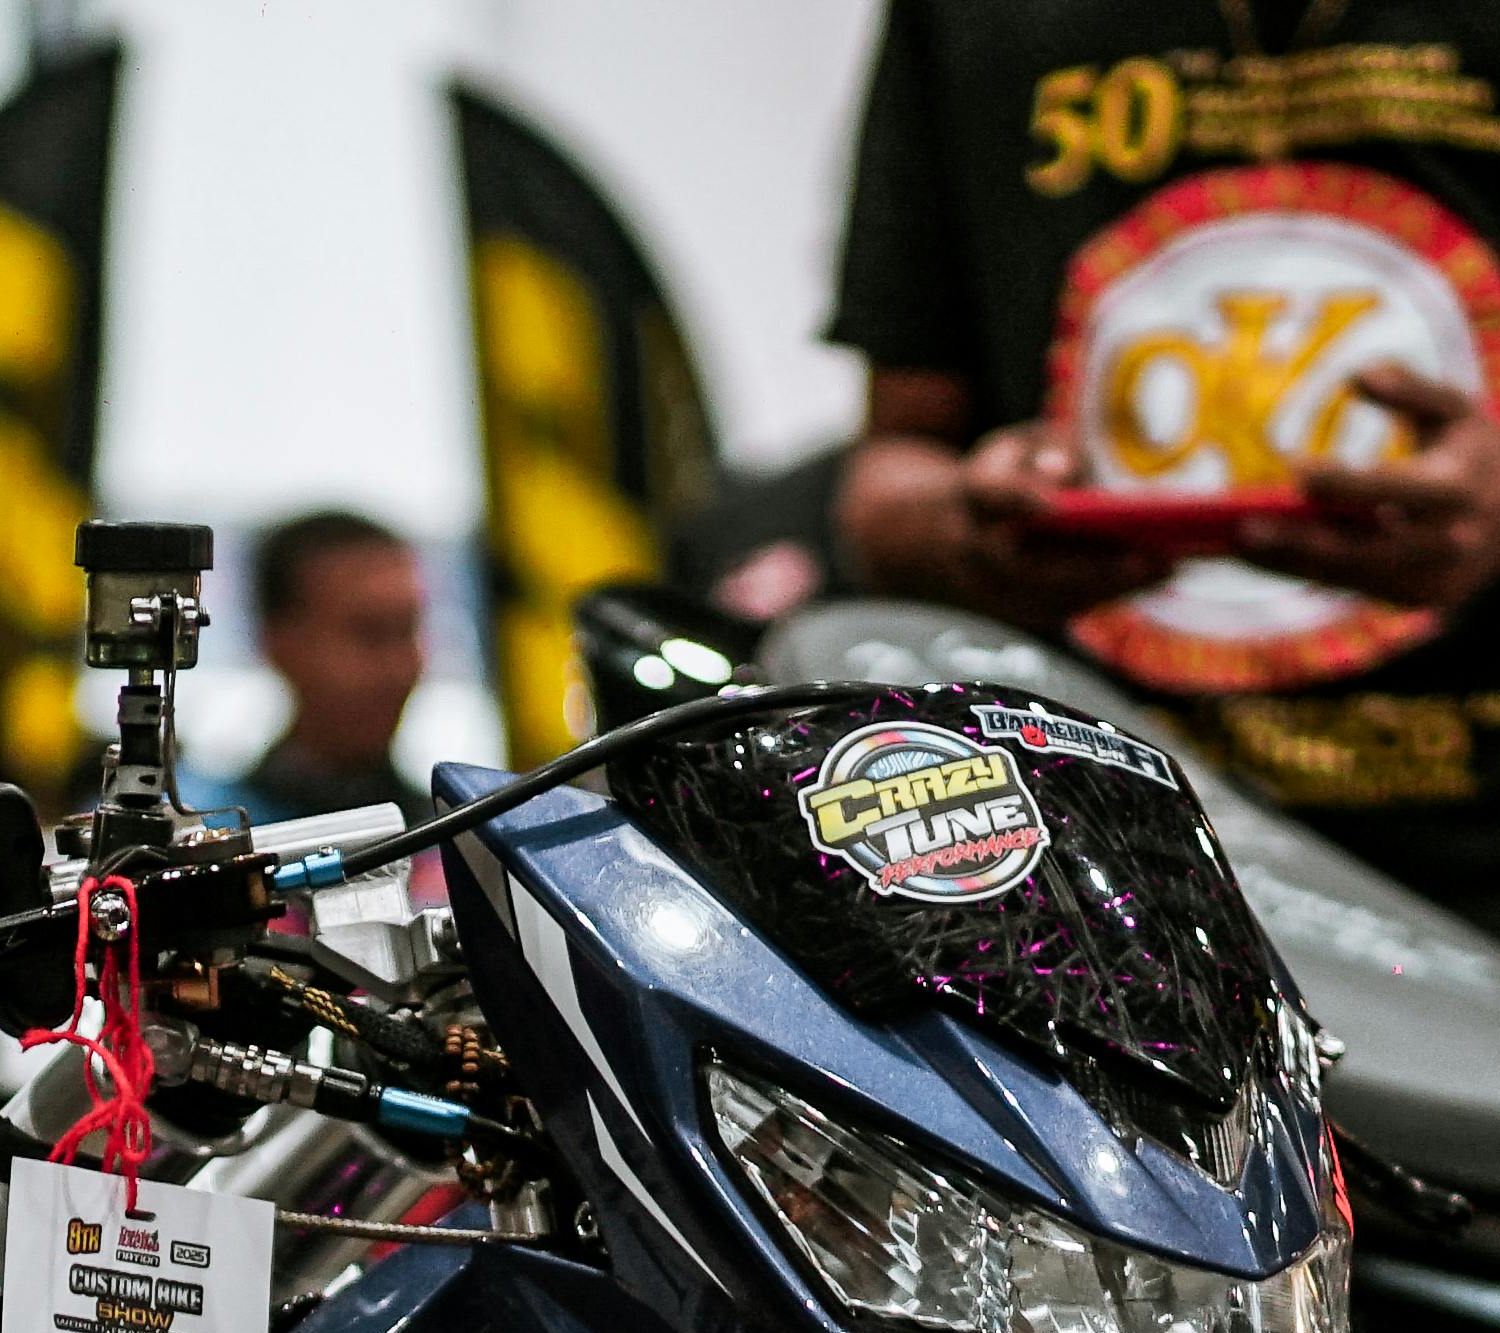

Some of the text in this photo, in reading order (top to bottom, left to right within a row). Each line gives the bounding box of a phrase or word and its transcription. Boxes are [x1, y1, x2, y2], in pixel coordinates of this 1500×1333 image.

[1027, 57, 1181, 197] 50
[810, 754, 1008, 843] CRAZY
[866, 794, 1028, 864] TUNE
[878, 827, 1043, 888] PERFORMANCE
[117, 1251, 159, 1266] NATION
[175, 1246, 206, 1263] 2025
[71, 1267, 202, 1311] CUSTOM BIKE
[98, 1302, 172, 1329] SHOW
